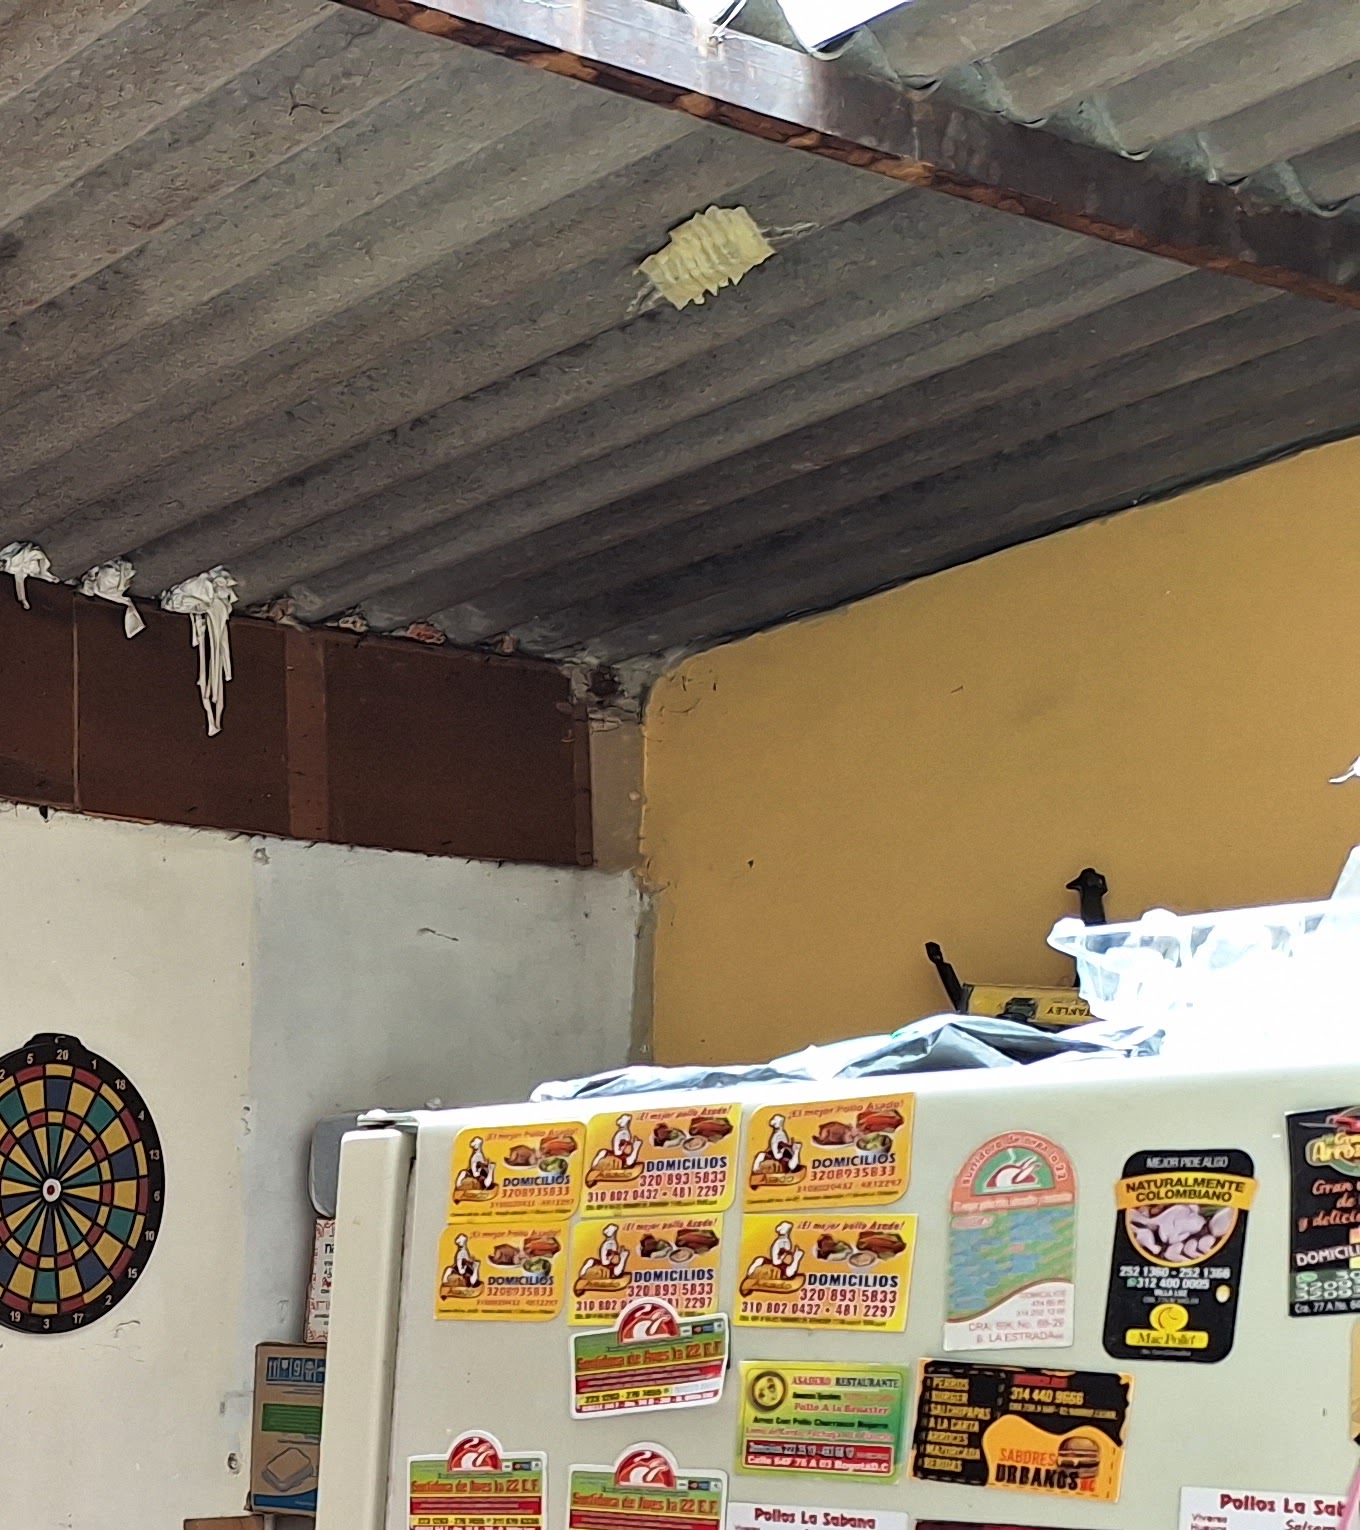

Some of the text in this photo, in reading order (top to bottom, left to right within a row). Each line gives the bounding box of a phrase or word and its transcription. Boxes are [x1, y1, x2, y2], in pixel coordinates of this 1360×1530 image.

[1047, 1007, 1090, 1016] TANLEY
[27, 1054, 33, 1064] 5
[56, 1050, 69, 1060] 20
[91, 1060, 96, 1070] 1
[115, 1079, 126, 1090] 18
[138, 1110, 144, 1120] 4
[149, 1150, 159, 1160] 13
[646, 1157, 727, 1172] DOMICILIOS
[812, 1153, 896, 1169] DOMICILIOS
[1146, 1157, 1179, 1168] MEJOR
[1202, 1157, 1228, 1167] ALGO
[502, 1175, 570, 1186] DOMICILIOS
[640, 1171, 726, 1186] 320 893 5833
[1126, 1177, 1245, 1193] NATURALMENTE
[588, 1191, 606, 1203] 310
[633, 1189, 658, 1200] 0432
[672, 1187, 691, 1198] 481
[697, 1185, 725, 1197] 2297
[1136, 1190, 1232, 1202] COLOMBIANO
[145, 1231, 154, 1241] 10
[128, 1268, 137, 1278] 15
[635, 1269, 714, 1282] DOMICILIOS
[1119, 1266, 1200, 1277] 252 252
[488, 1276, 554, 1285] DOMICILIOS
[808, 1274, 898, 1287] DOMICILIOS
[1137, 1278, 1156, 1288] 312
[628, 1283, 713, 1296] 320 893 5833
[105, 1295, 111, 1305] 2
[800, 1289, 897, 1303] 320 893 5833
[576, 1301, 594, 1311] 310
[685, 1297, 712, 1308] 2297
[742, 1302, 895, 1317] 310 802 0432 481 2297
[10, 1312, 21, 1321] 19
[73, 1313, 84, 1323] 17
[43, 1319, 50, 1328] 3
[835, 1377, 899, 1387] RESTAURANTE
[1000, 1448, 1056, 1466] SABORES
[995, 1465, 1078, 1490] URBANOS
[1220, 1494, 1305, 1514] Pollos La
[755, 1508, 875, 1529] Pollos La Sabana
